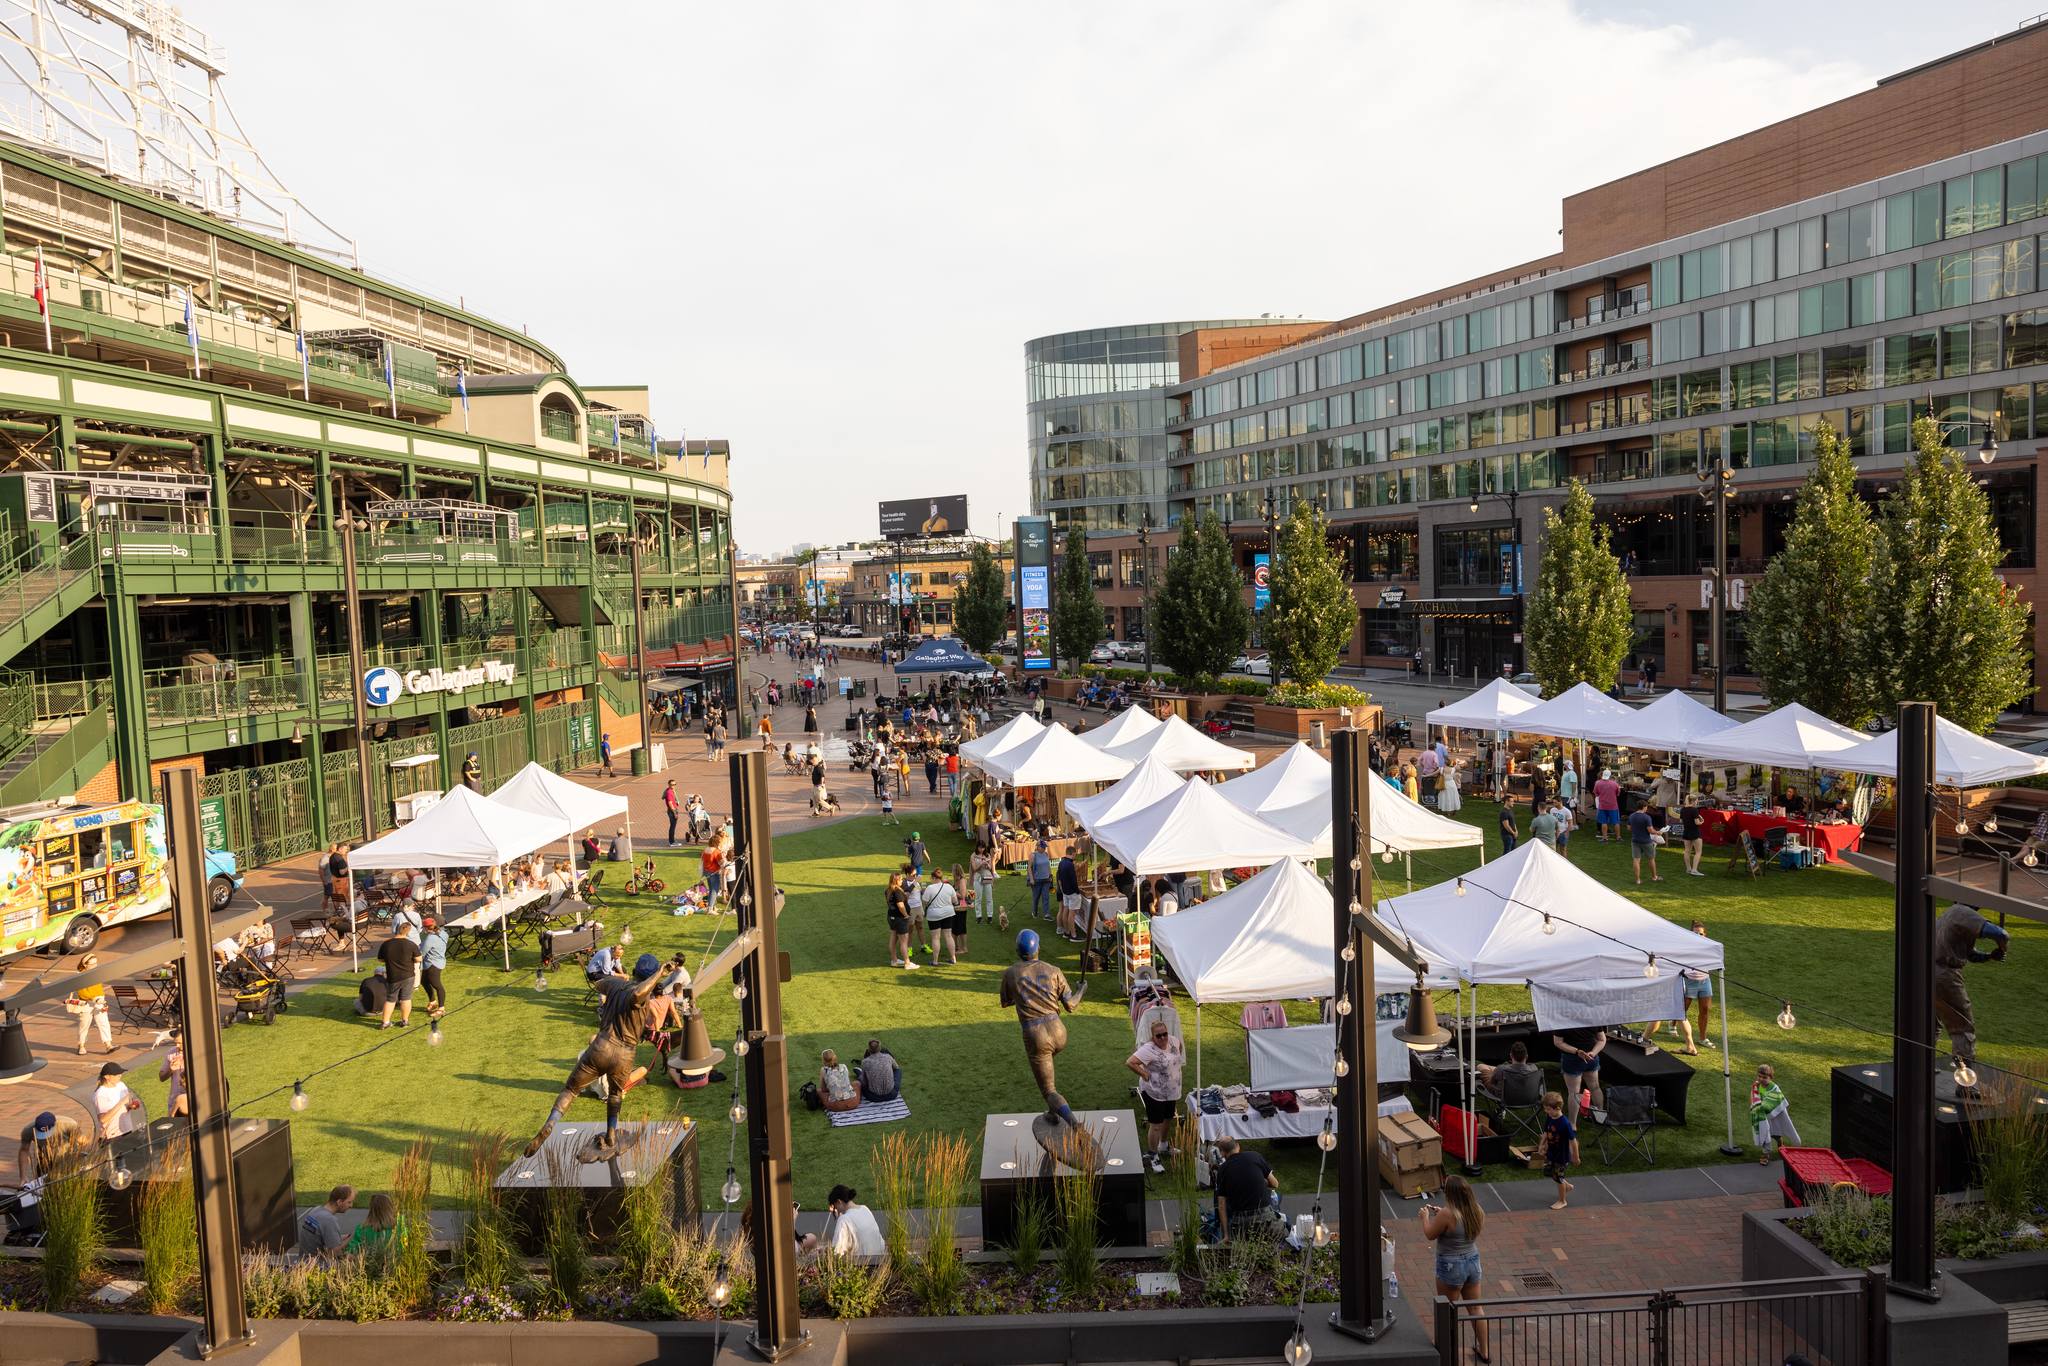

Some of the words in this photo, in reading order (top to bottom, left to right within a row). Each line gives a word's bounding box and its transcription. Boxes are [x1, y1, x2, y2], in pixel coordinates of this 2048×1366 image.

[383, 501, 426, 511] GRILL
[1412, 602, 1460, 611] ZACHARY
[405, 664, 485, 694] Gallagher
[482, 660, 515, 685] Way
[229, 734, 237, 743] 4
[73, 813, 103, 828] KONA
